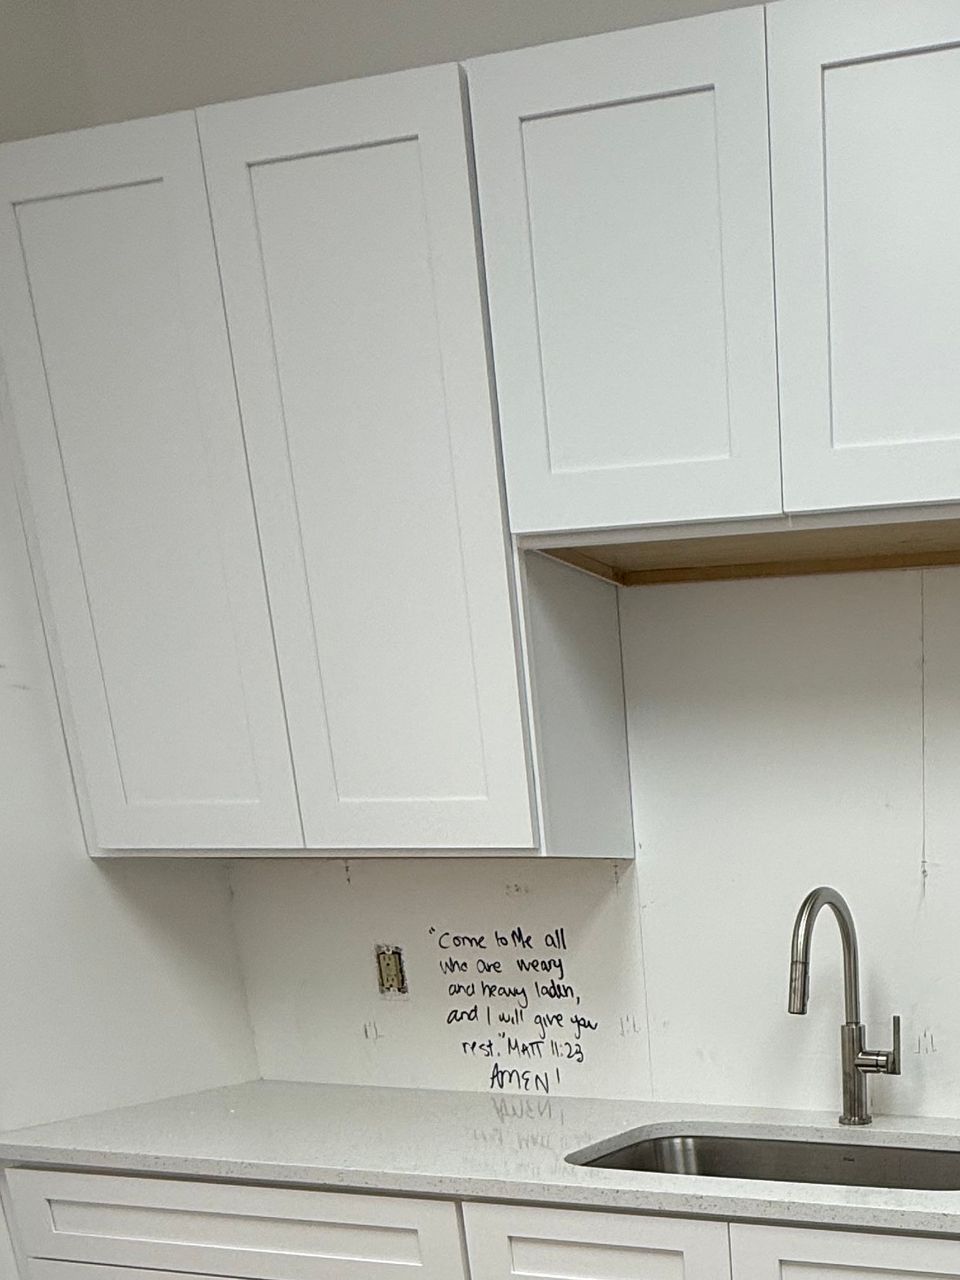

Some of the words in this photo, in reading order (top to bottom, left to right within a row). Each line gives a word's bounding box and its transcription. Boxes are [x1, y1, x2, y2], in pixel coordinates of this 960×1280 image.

[495, 930, 509, 946] to
[511, 927, 533, 949] Me
[545, 928, 567, 949] all
[439, 957, 468, 975] who
[477, 959, 502, 973] are
[516, 958, 564, 980] weary
[449, 983, 475, 996] and
[481, 981, 528, 1008] heavy
[447, 1005, 478, 1024] and
[487, 1006, 491, 1025] I
[498, 1008, 524, 1025] will
[534, 1013, 563, 1039] give
[570, 1015, 598, 1039] you
